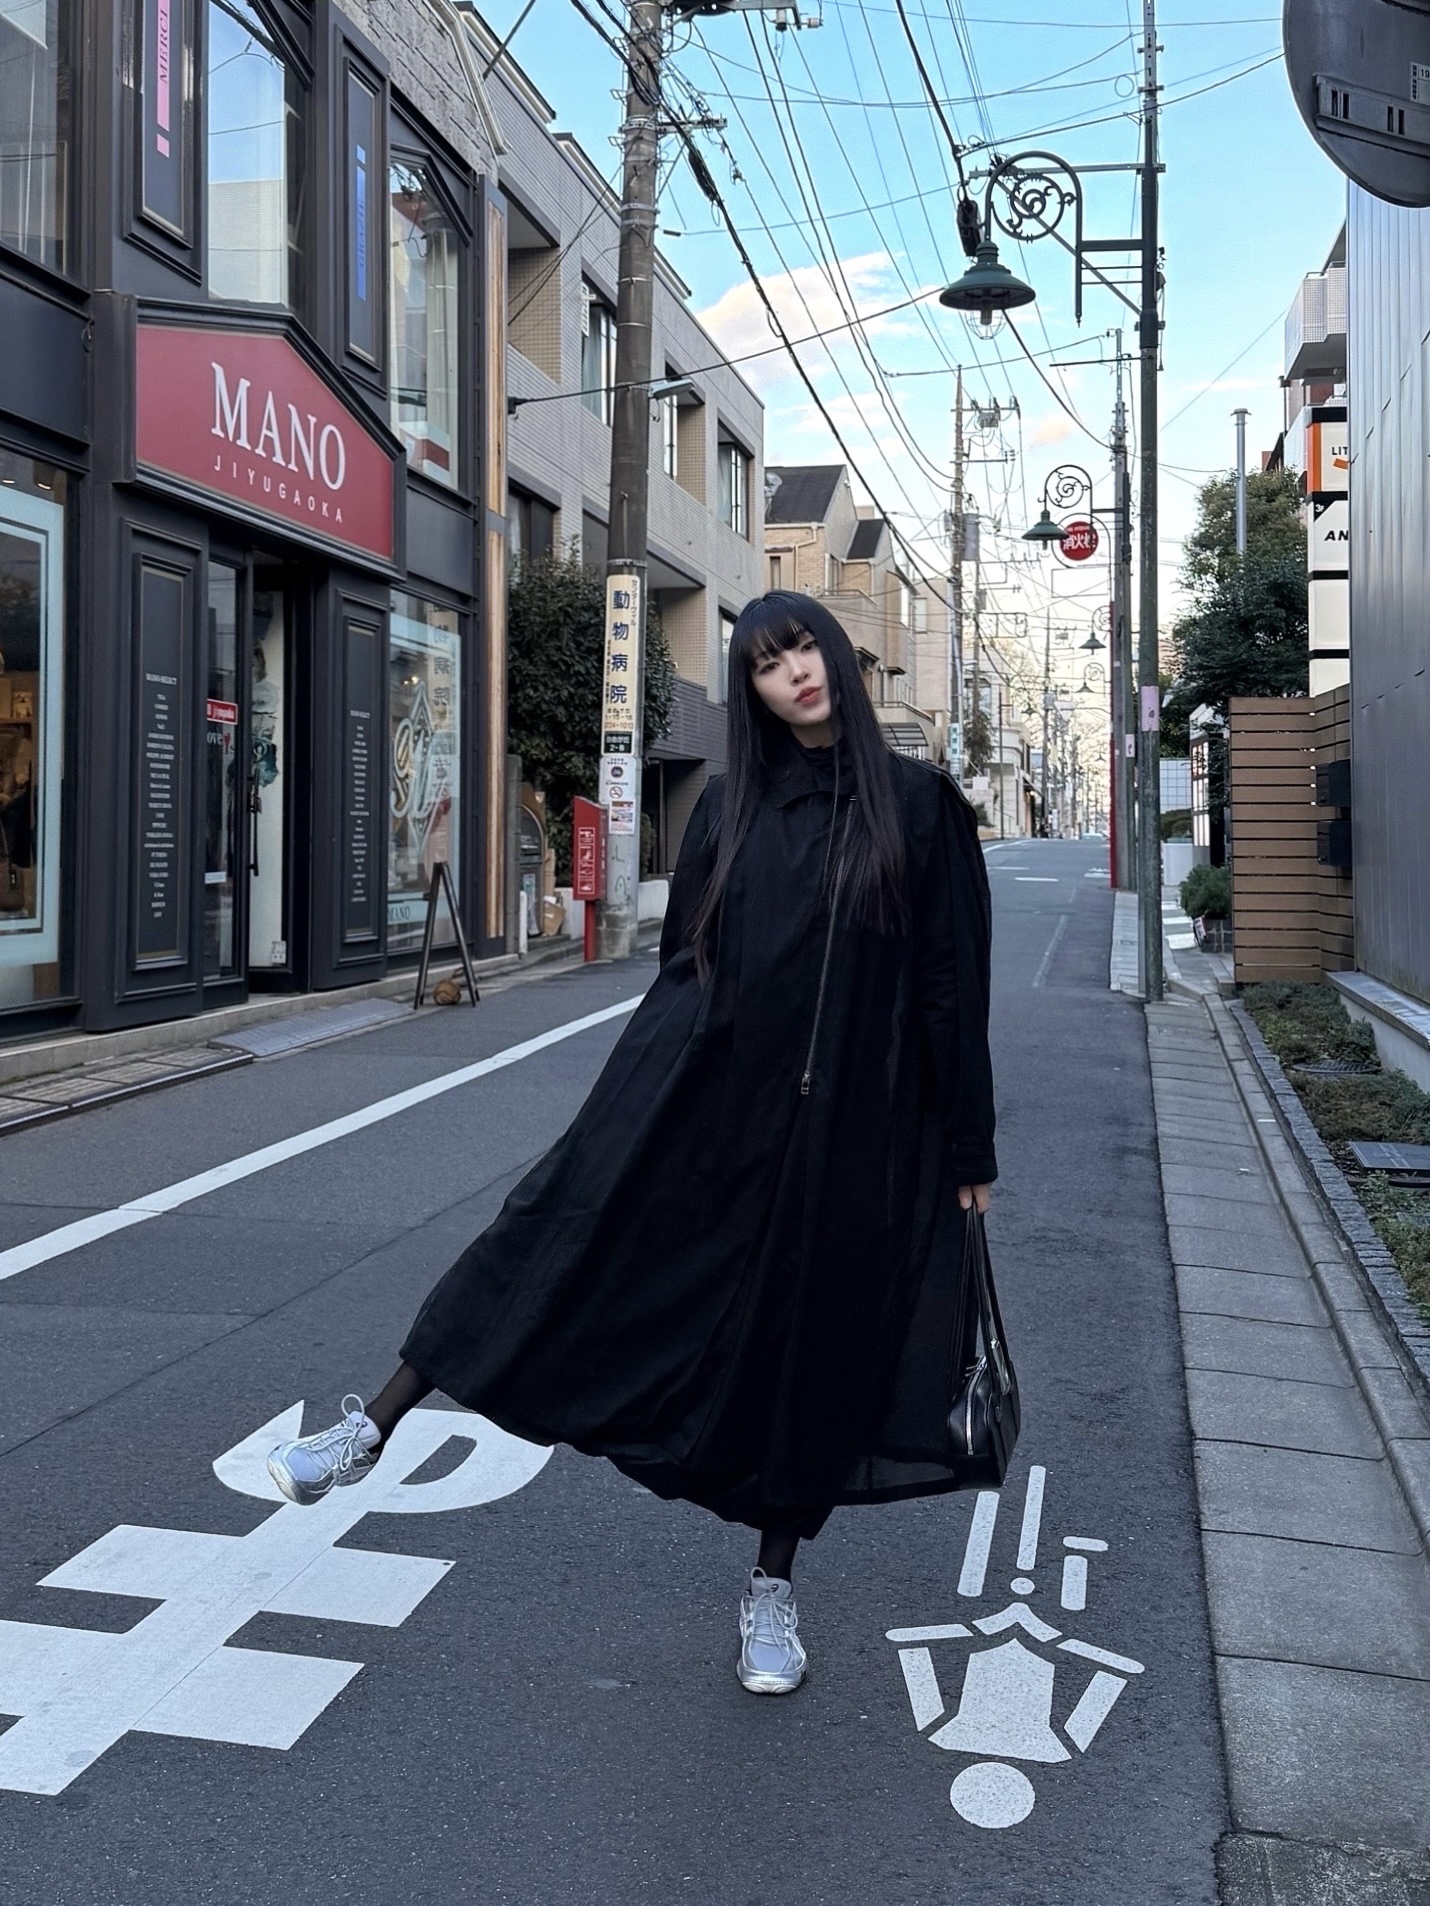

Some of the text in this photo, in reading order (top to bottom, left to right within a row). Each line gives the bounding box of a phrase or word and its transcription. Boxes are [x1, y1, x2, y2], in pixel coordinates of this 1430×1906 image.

[159, 8, 169, 84] MERCI
[211, 362, 345, 490] MANO
[214, 455, 342, 523] JIYUGAOKA
[1315, 503, 1325, 513] 3F
[1324, 530, 1349, 541] AN
[609, 590, 631, 704] 動物病院
